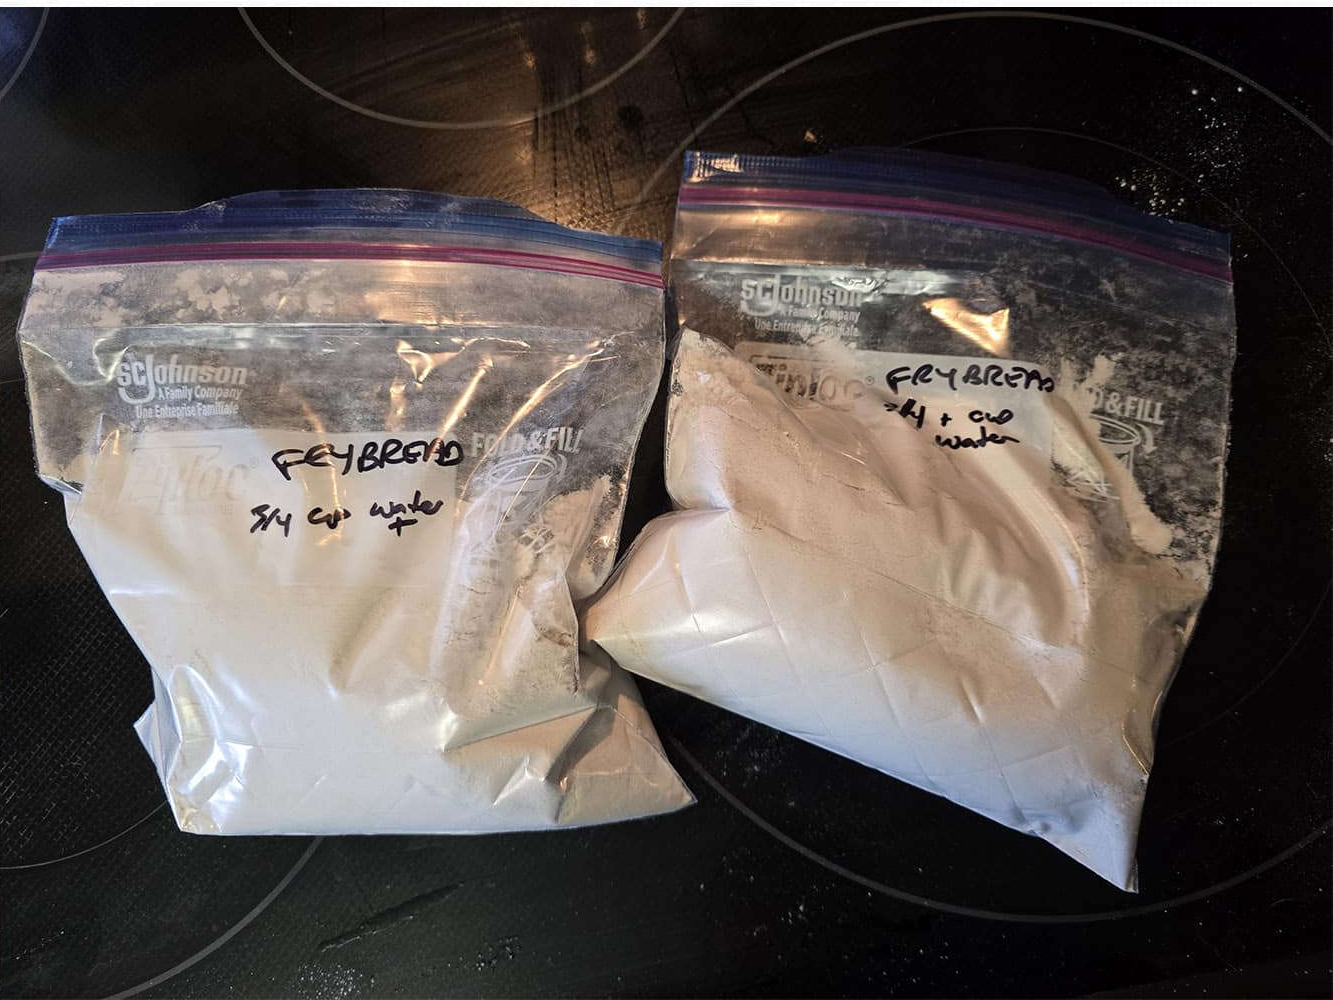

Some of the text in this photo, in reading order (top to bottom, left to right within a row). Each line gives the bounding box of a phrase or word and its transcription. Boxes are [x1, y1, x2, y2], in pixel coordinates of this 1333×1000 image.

[158, 385, 243, 401] A Family Company
[136, 406, 154, 419] Une
[155, 403, 196, 418] Entreprise
